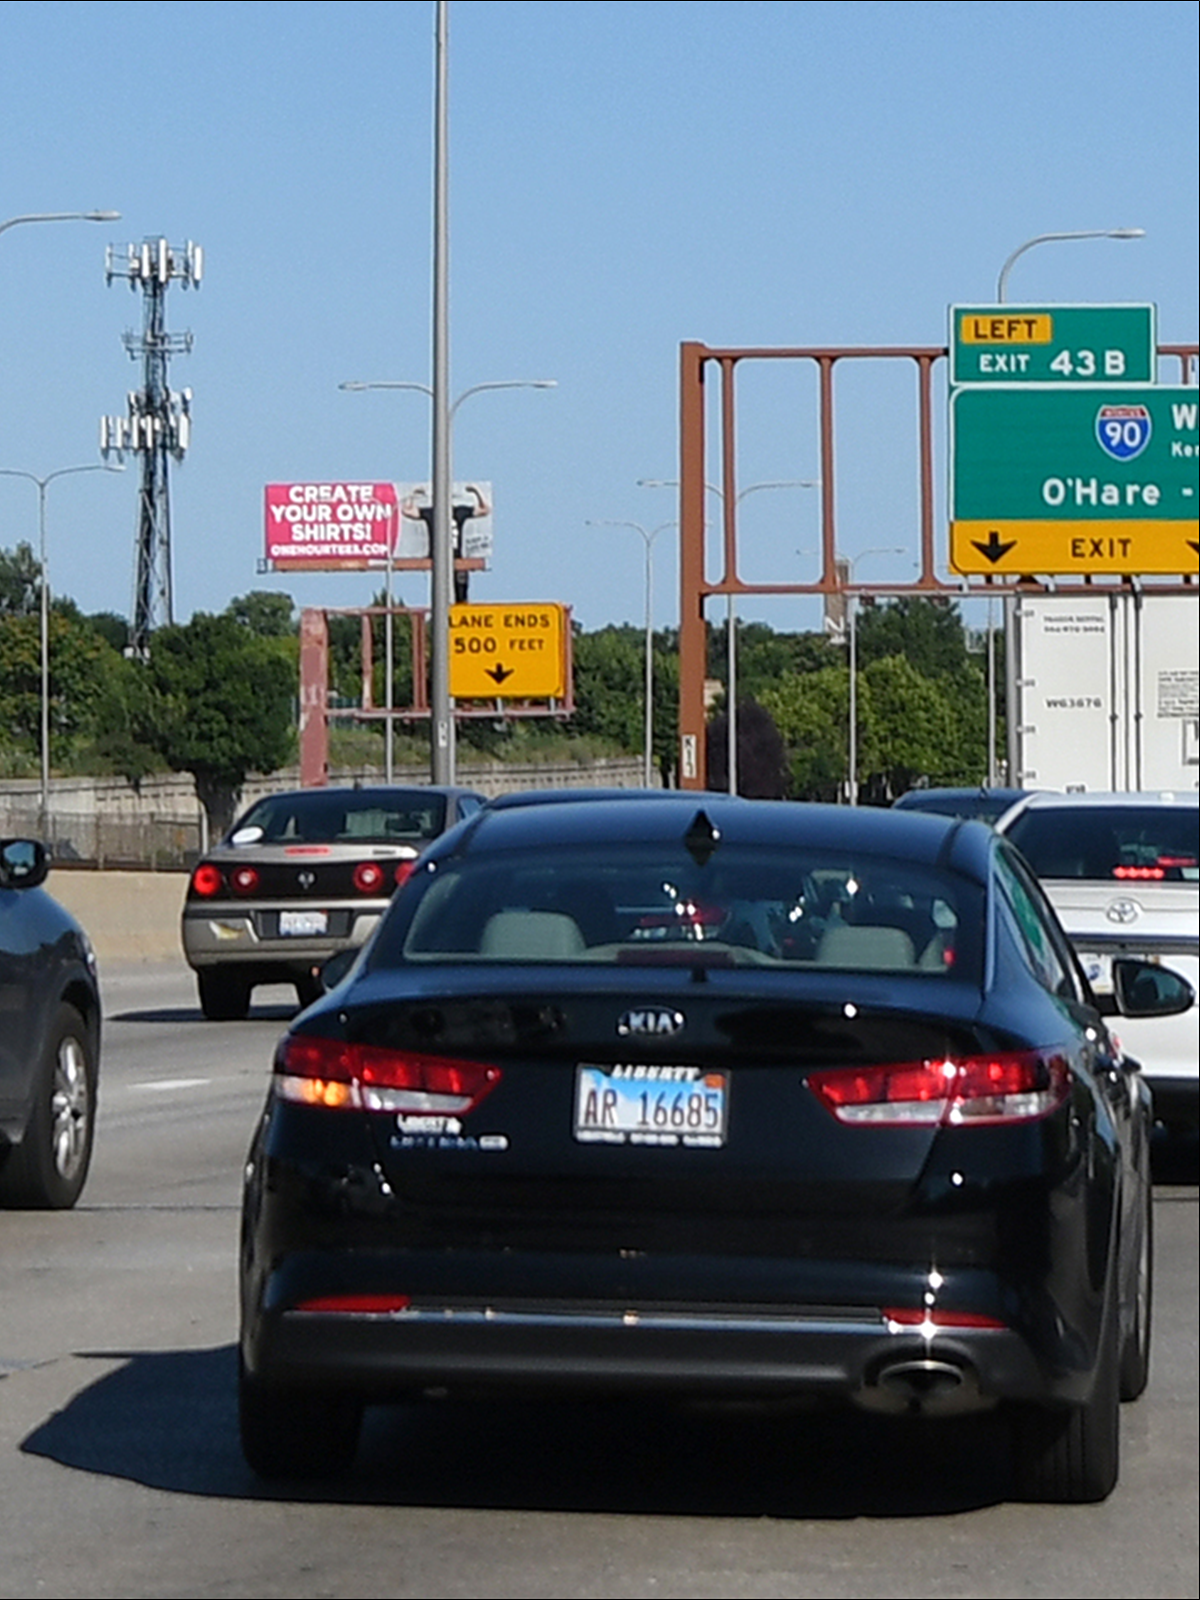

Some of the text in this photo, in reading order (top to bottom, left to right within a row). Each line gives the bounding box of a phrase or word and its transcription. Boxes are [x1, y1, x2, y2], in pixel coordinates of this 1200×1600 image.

[974, 319, 1037, 339] LEFT
[980, 353, 1030, 372] EXIT
[1104, 421, 1141, 448] 90
[289, 485, 374, 504] CREATE
[1042, 477, 1161, 507] O'Hare
[271, 504, 392, 522] YOUR OWN
[291, 522, 372, 542] SHIRTS!
[1071, 538, 1131, 558] EXIT
[448, 614, 550, 628] LANE ENDS
[454, 636, 545, 654] 500 FEET
[629, 1011, 674, 1035] KIA
[611, 1064, 701, 1082] LIBERTY
[584, 1089, 719, 1129] AR 16685
